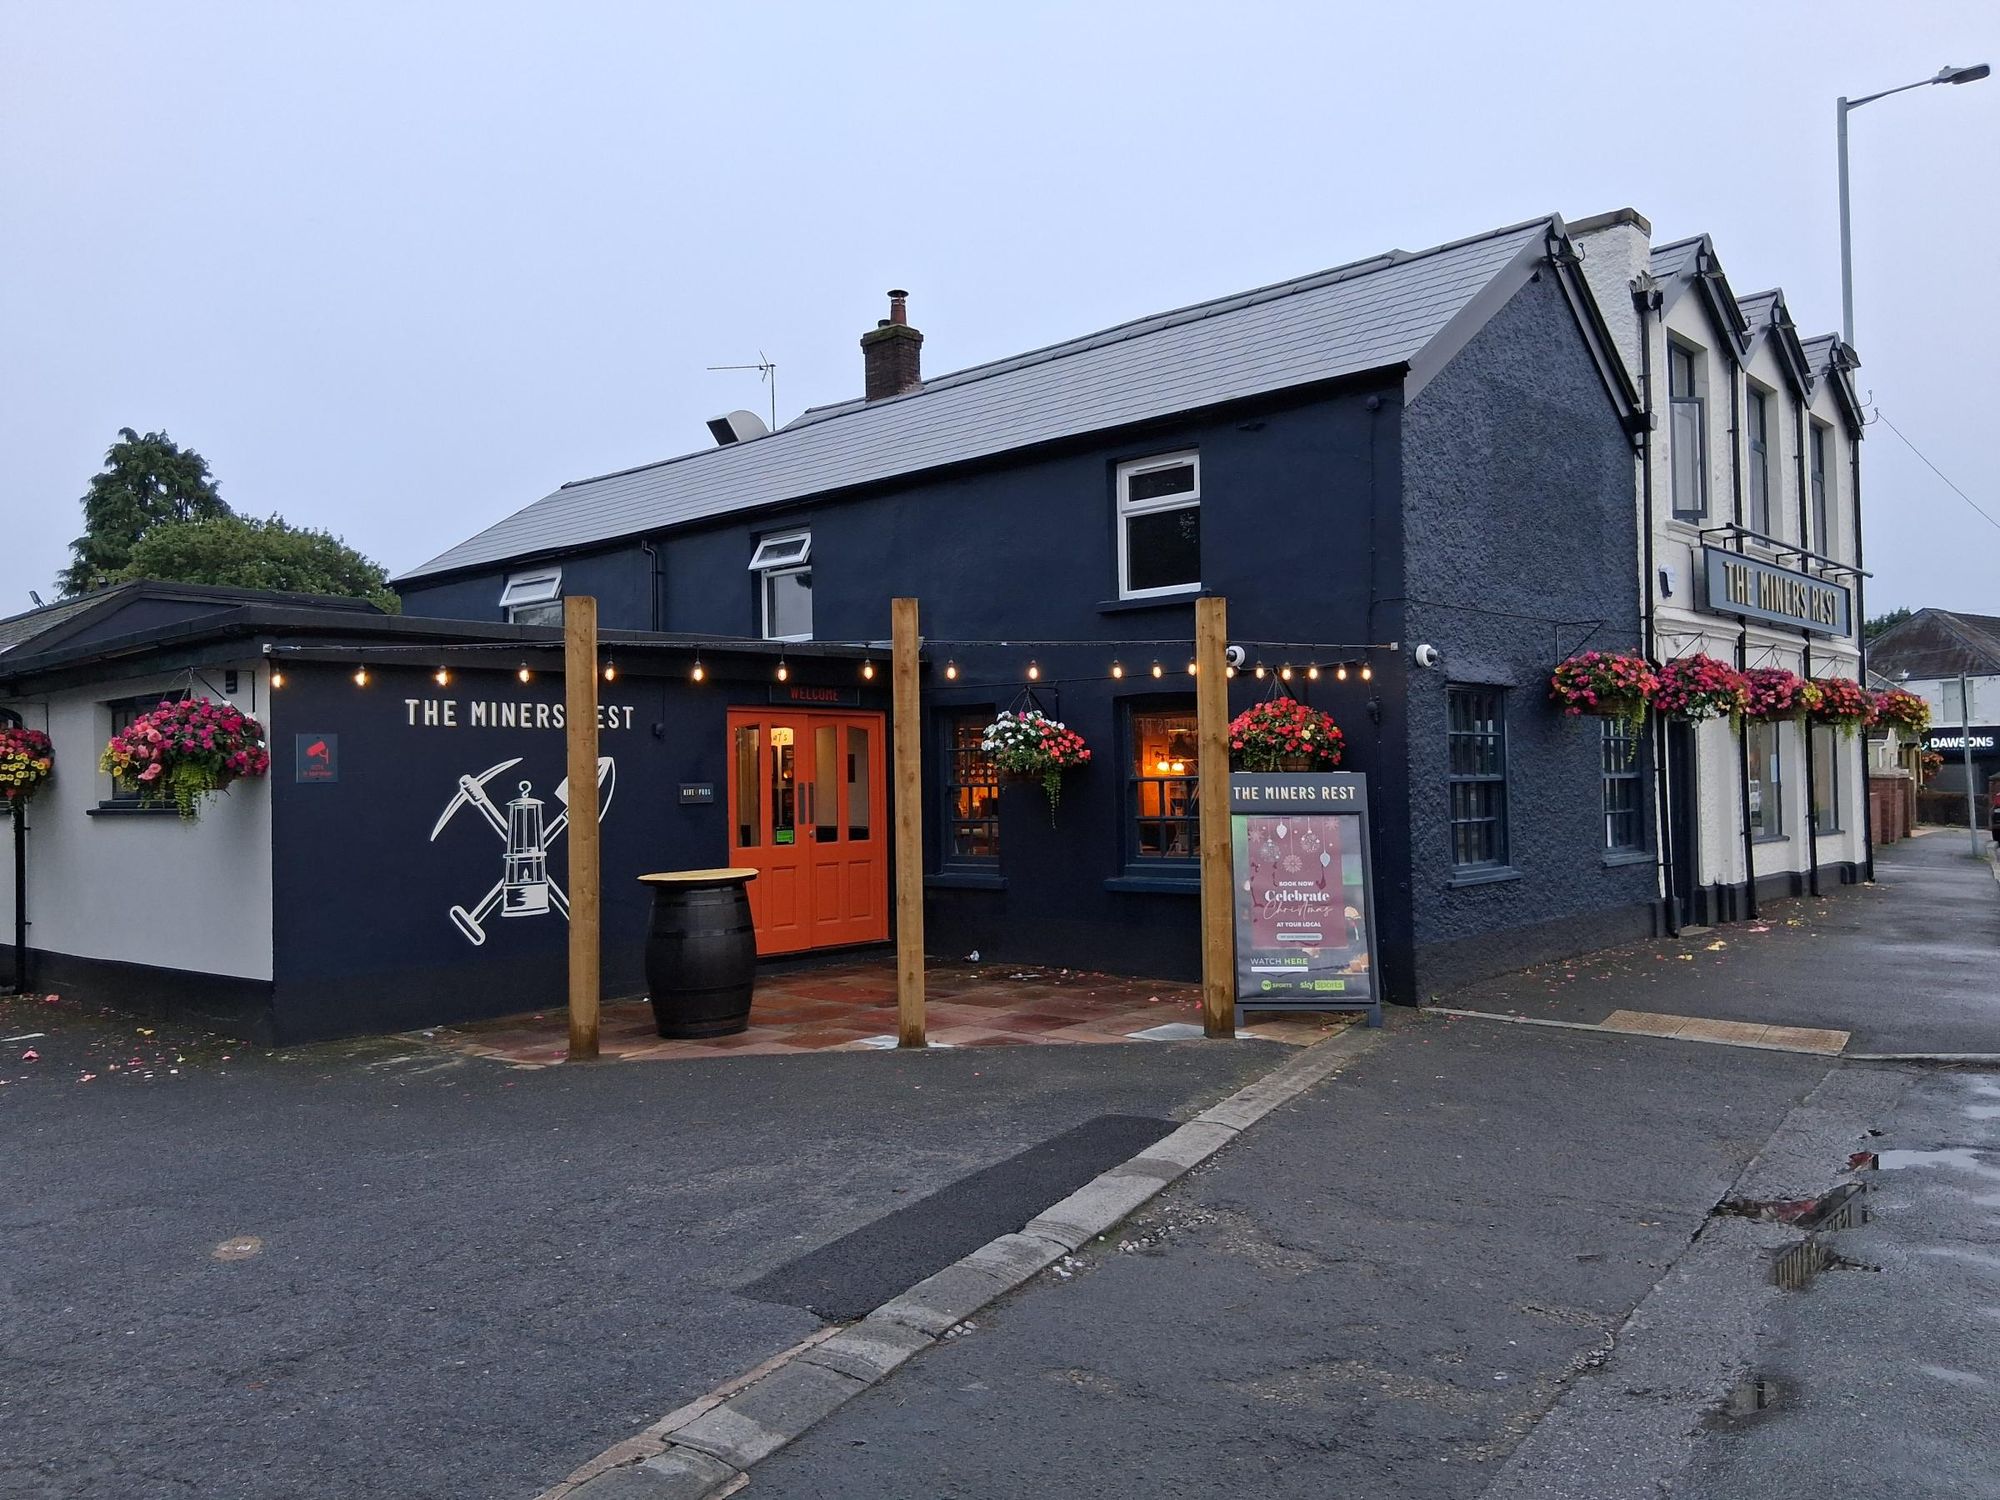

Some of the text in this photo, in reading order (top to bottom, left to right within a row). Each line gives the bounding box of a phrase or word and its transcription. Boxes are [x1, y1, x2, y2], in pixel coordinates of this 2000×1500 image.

[1724, 561, 1838, 626] THE MINERS REST
[791, 687, 839, 701] WELCOME
[405, 699, 635, 730] THE MINERS EST
[1930, 736, 1994, 748] DAWSONS
[1233, 786, 1356, 800] THE MINERS REST
[1264, 889, 1330, 902] Celebrate
[1263, 899, 1334, 920] Christmas
[1250, 957, 1308, 965] WATCH HERE
[1300, 981, 1314, 990] sky
[1315, 981, 1343, 990] sports
